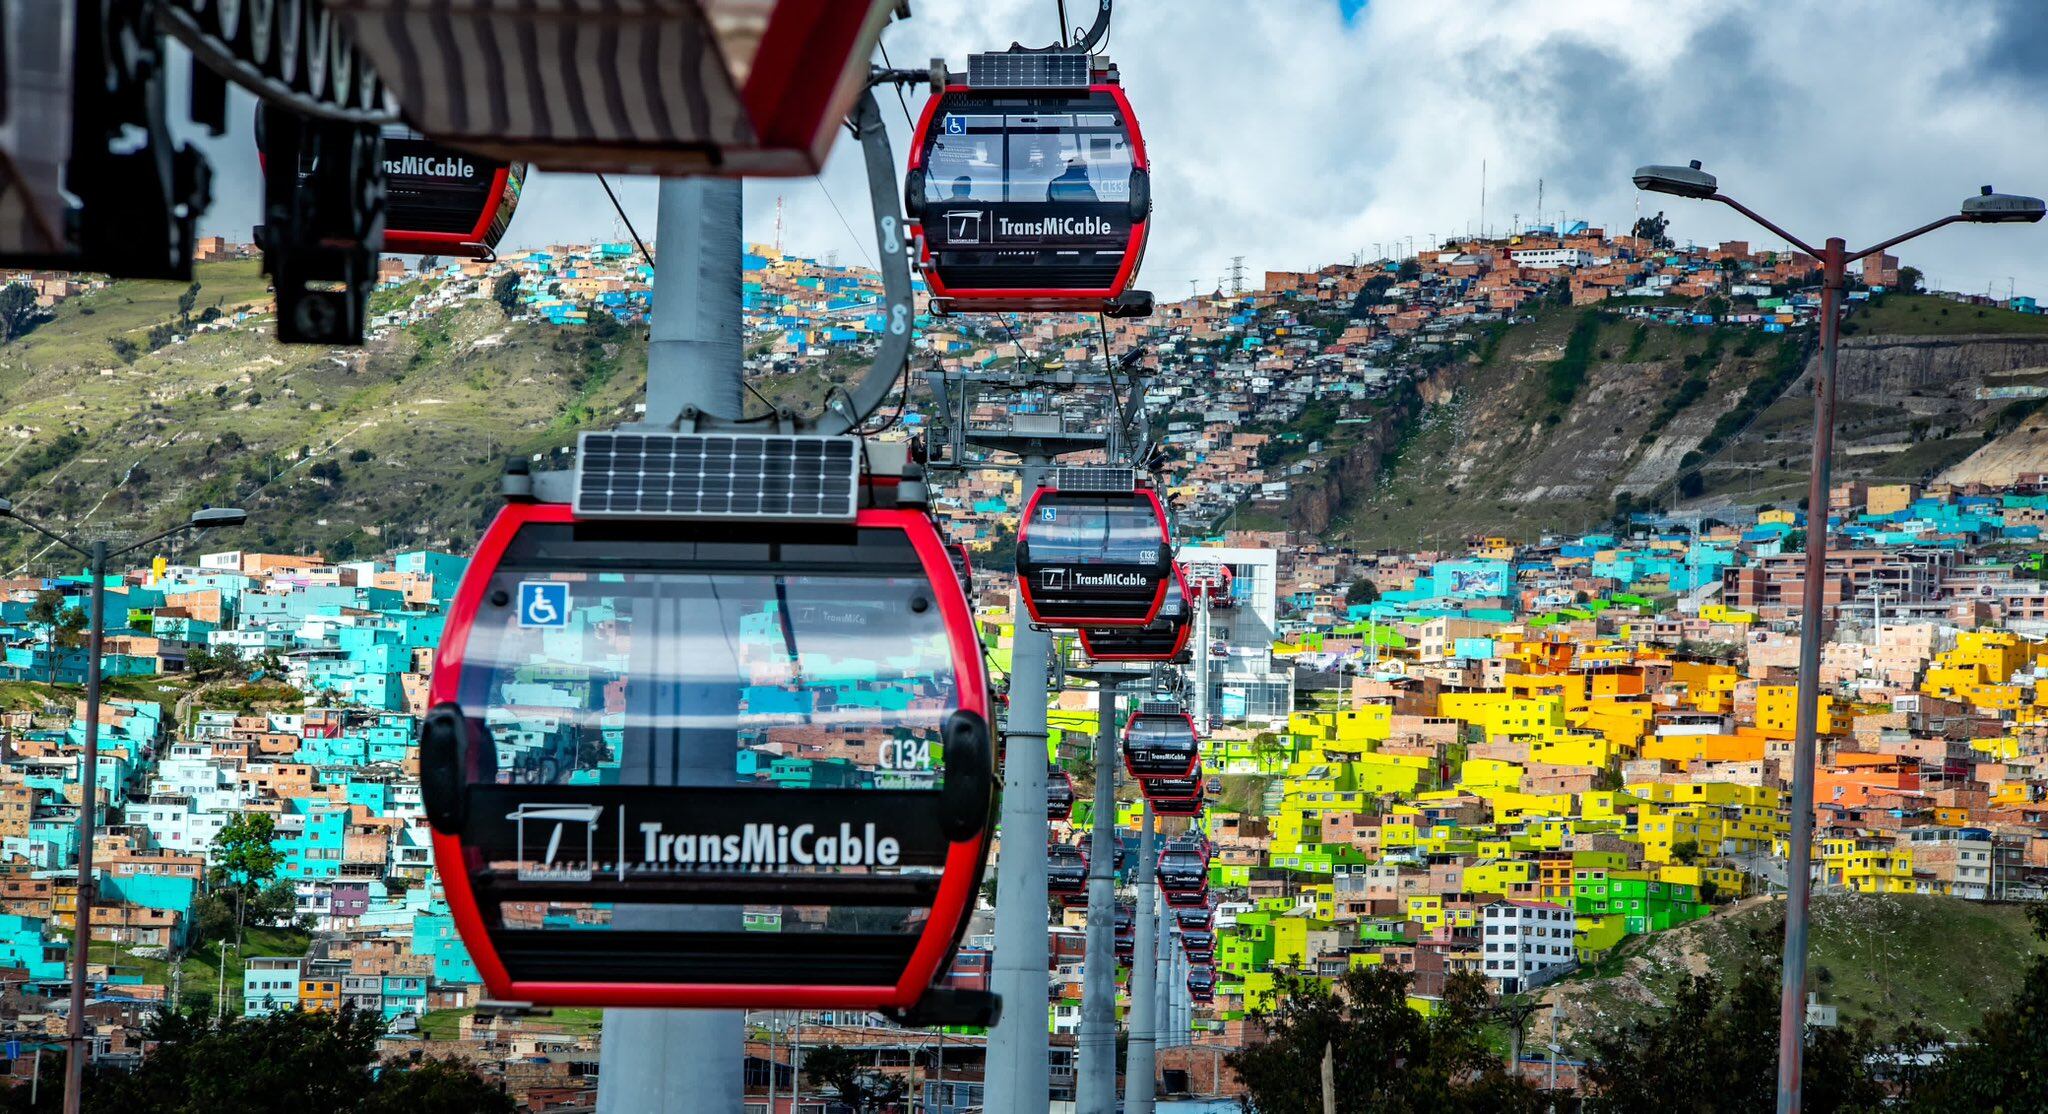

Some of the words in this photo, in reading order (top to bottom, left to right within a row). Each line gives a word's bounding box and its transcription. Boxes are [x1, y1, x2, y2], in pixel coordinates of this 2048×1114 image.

[382, 156, 474, 178] nsMiCable
[1100, 179, 1124, 193] C133
[998, 216, 1112, 236] TransMiCable
[1139, 550, 1156, 560] C132
[1075, 573, 1147, 586] TransMiCable
[878, 739, 931, 771] C134
[639, 822, 901, 866] TransMiCable
